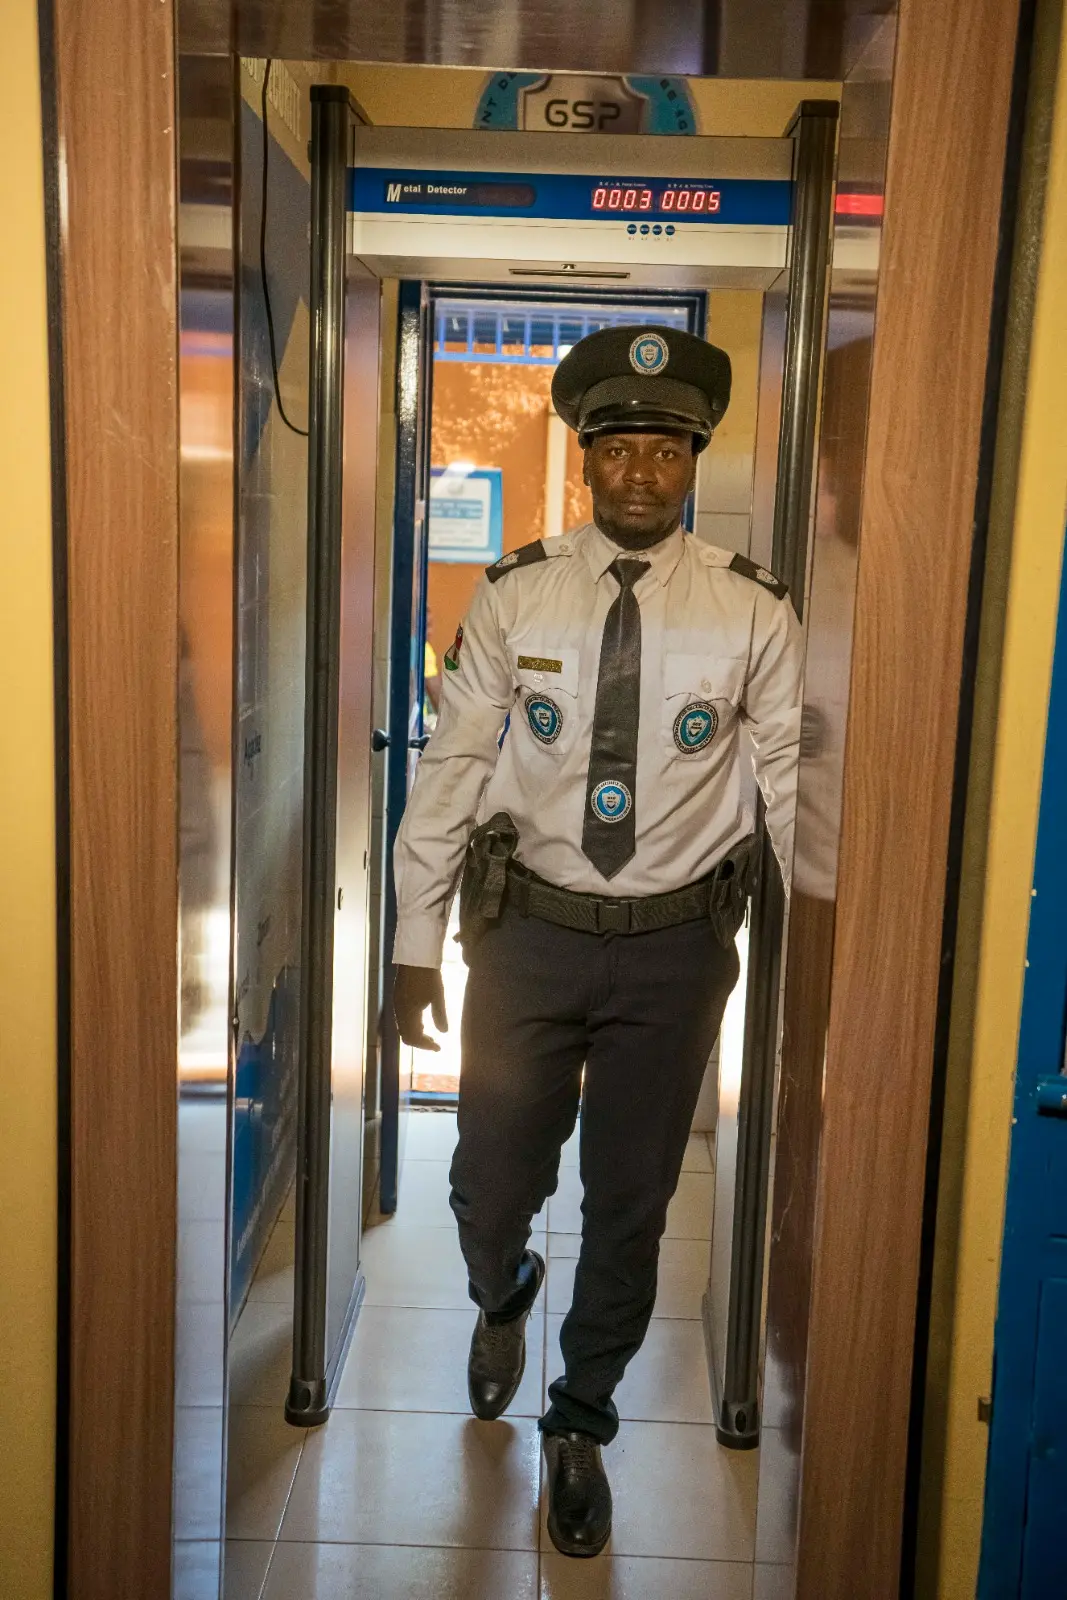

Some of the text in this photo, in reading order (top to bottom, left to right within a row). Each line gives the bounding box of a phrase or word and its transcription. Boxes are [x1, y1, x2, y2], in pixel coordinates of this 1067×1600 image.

[545, 99, 621, 130] GSP
[386, 183, 467, 202] Metal Detector
[592, 188, 720, 210] 0003 0005
